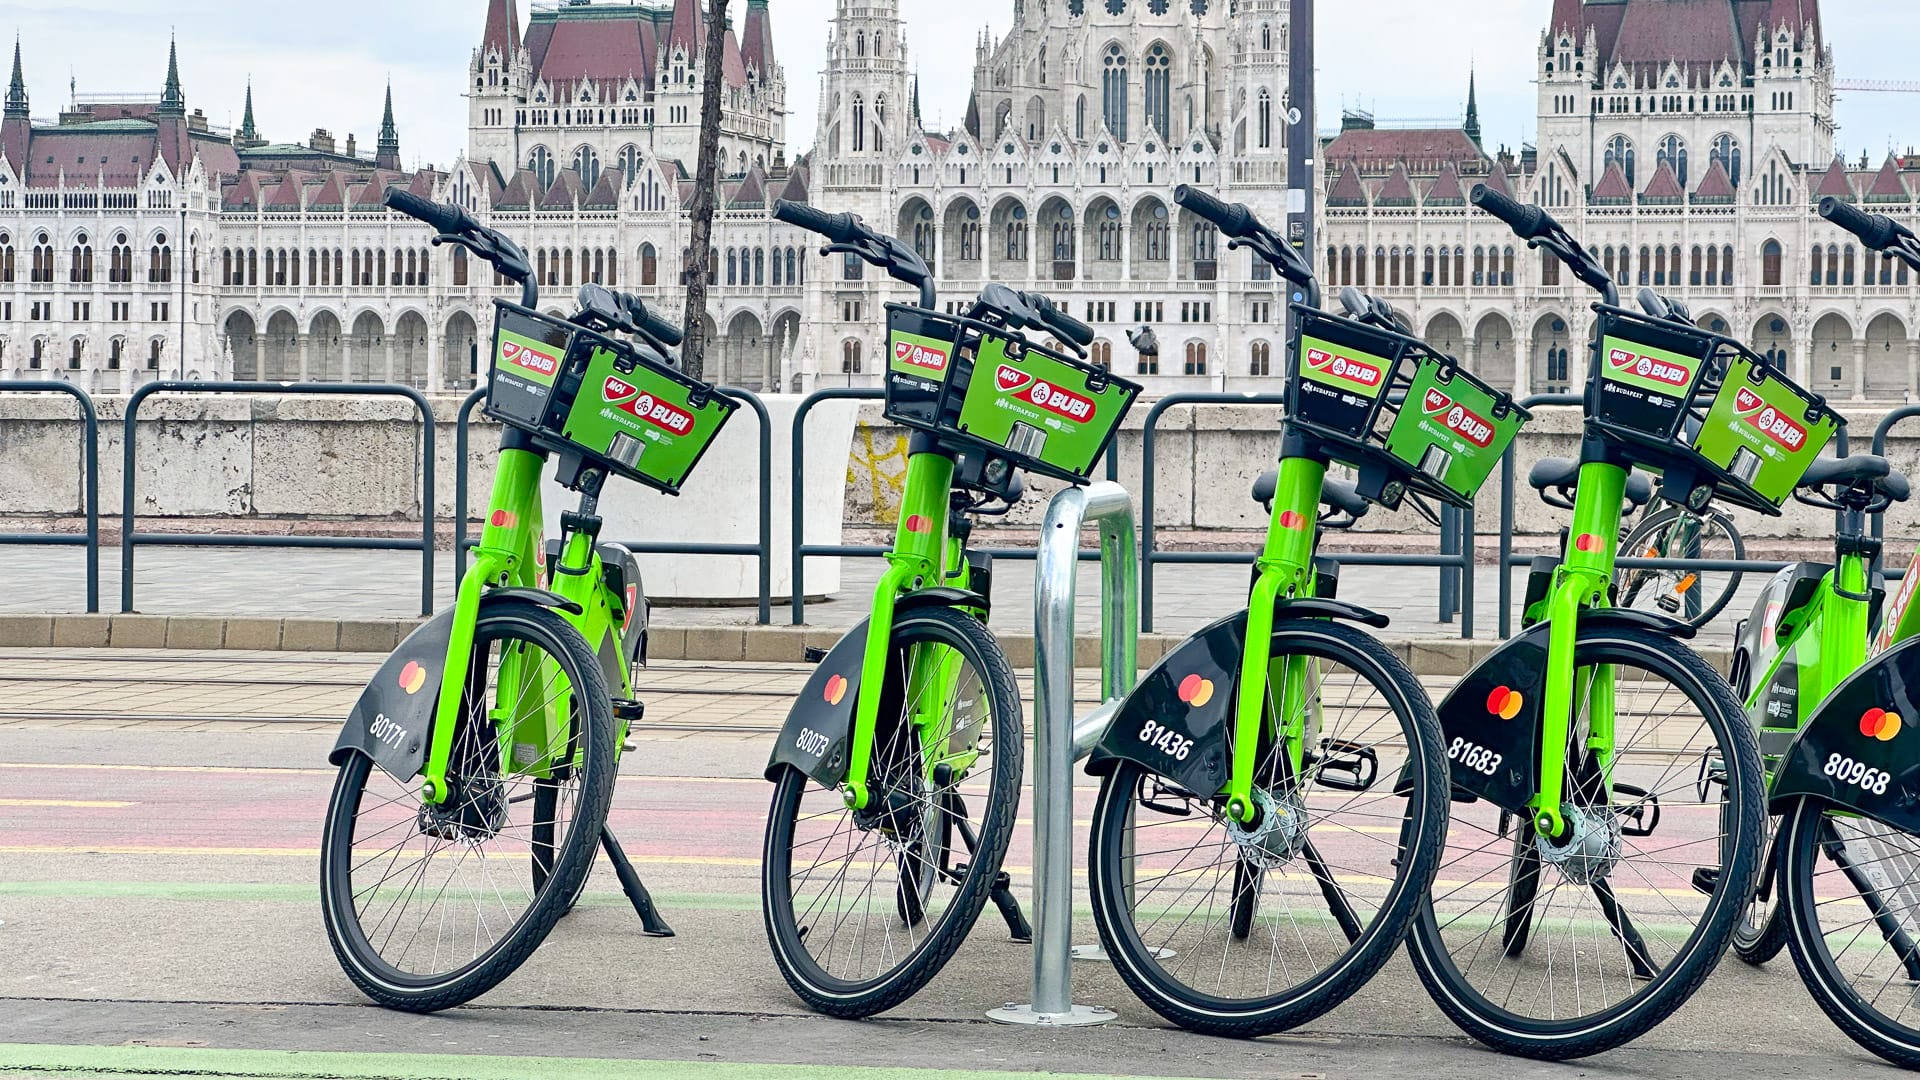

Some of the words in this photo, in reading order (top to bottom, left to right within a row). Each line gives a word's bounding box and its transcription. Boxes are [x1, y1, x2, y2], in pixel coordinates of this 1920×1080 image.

[530, 354, 554, 372] BUBI
[922, 351, 944, 366] BUBI
[1309, 350, 1324, 361] MOL
[1345, 363, 1378, 383] BUBI
[1611, 350, 1628, 362] MOL
[1651, 363, 1686, 382] BUBI
[606, 379, 627, 395] MOL
[650, 404, 690, 431] BUBI
[999, 368, 1020, 383] MOL
[1048, 391, 1091, 418] BUBI
[1312, 386, 1338, 399] BUDAPEST
[1616, 386, 1643, 399] BUDAPEST
[612, 412, 641, 431] BUDAPEST
[1008, 403, 1039, 420] BUDAPEST
[1427, 391, 1444, 406] MOL
[1459, 416, 1492, 443] BUBI
[1738, 391, 1756, 407] MOL
[1770, 418, 1804, 447] BUBI
[370, 714, 407, 749] 80171
[796, 728, 829, 757] 80073
[1139, 720, 1193, 761] 81436
[1447, 737, 1502, 775] 81683
[1823, 752, 1891, 796] 80968
